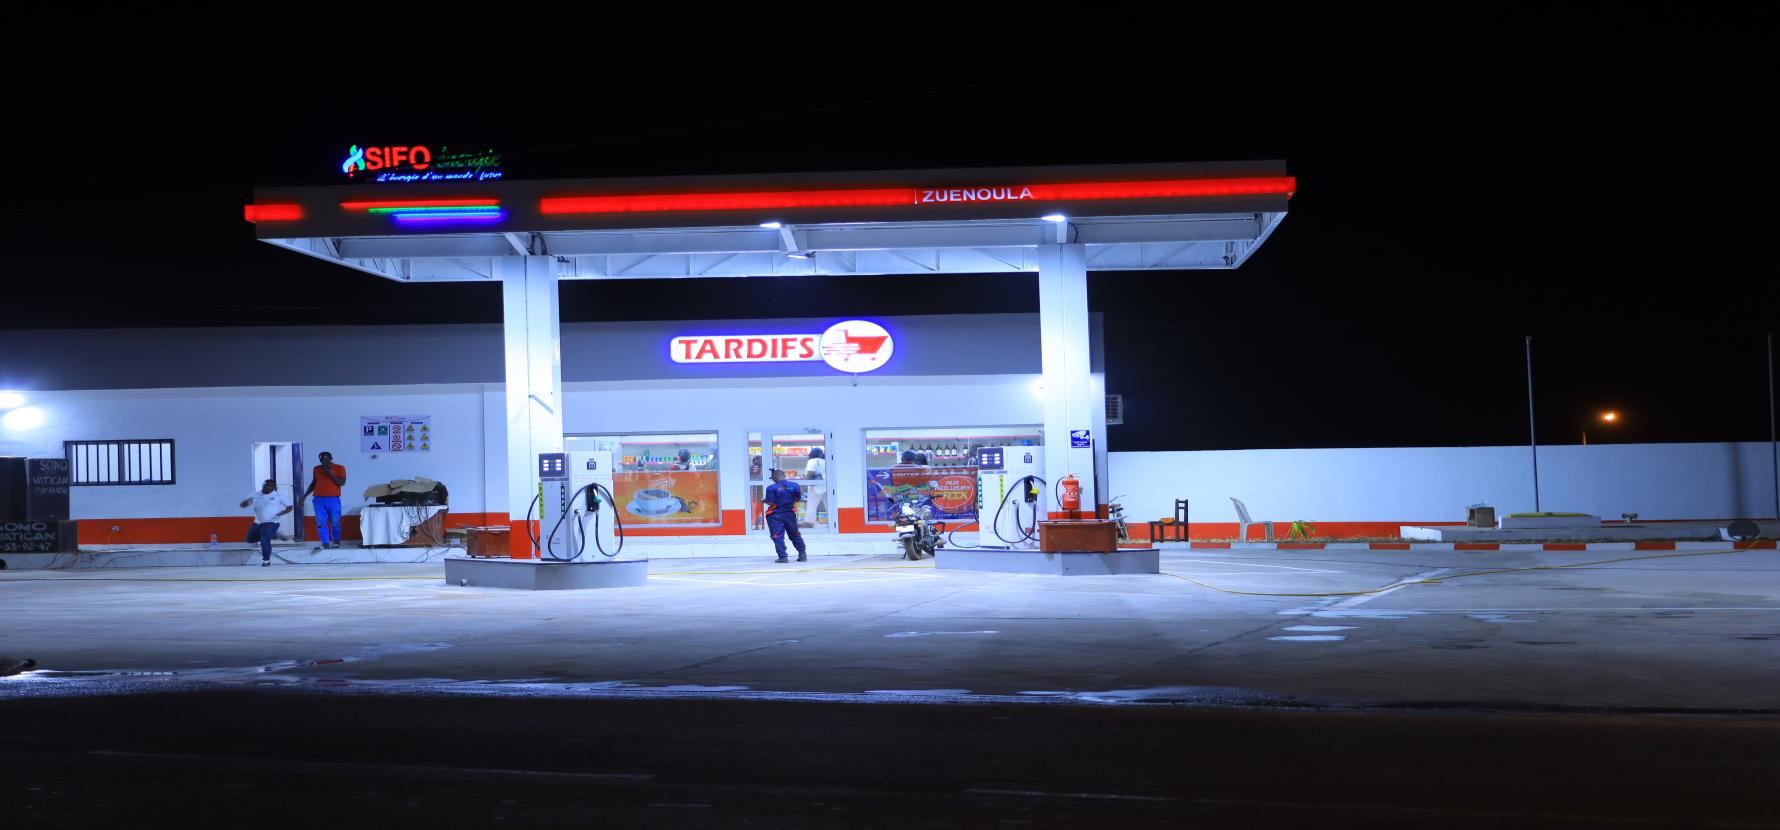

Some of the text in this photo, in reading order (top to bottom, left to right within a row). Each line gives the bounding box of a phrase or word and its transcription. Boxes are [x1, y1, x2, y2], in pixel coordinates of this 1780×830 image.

[365, 146, 431, 170] SIFO
[922, 187, 1034, 203] ZUENOULA
[678, 337, 815, 360] TARDIFS
